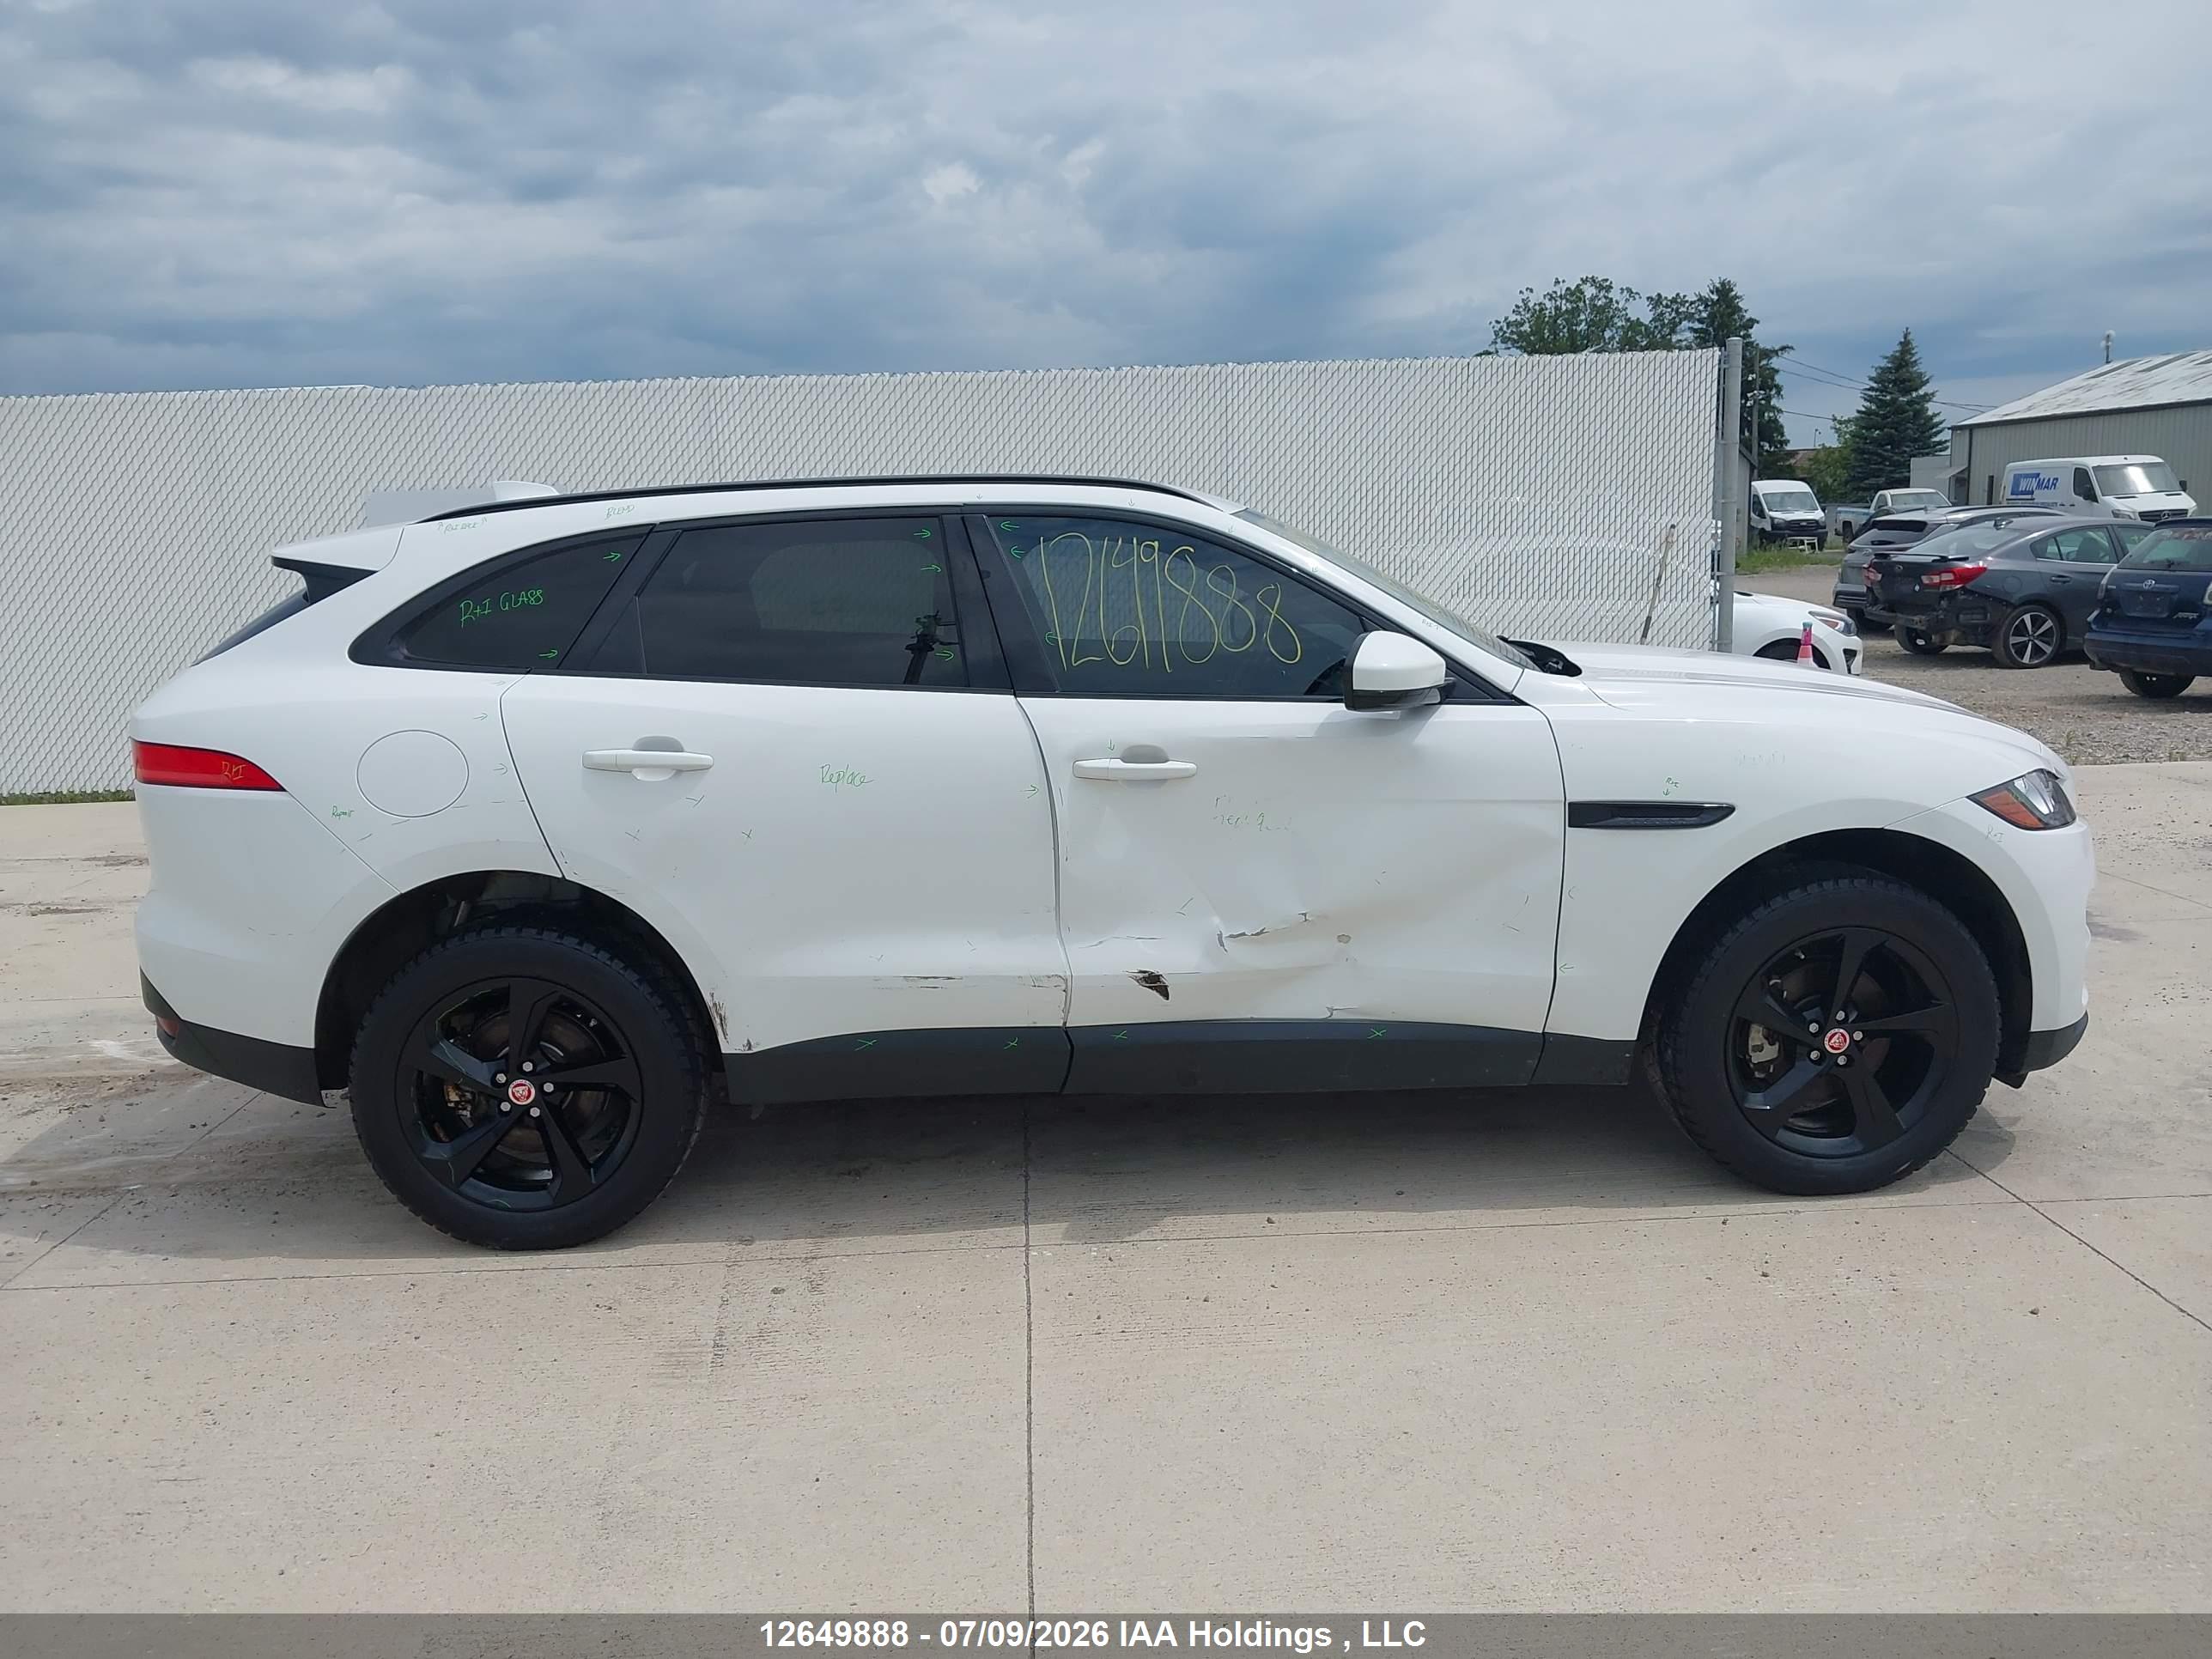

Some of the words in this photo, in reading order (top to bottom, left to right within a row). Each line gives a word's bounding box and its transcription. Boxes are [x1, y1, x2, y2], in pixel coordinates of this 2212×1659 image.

[2019, 477, 2059, 491] WINMAR
[500, 589, 544, 611] GLASS
[1039, 532, 1302, 673] 12649888
[818, 763, 875, 793] Replace
